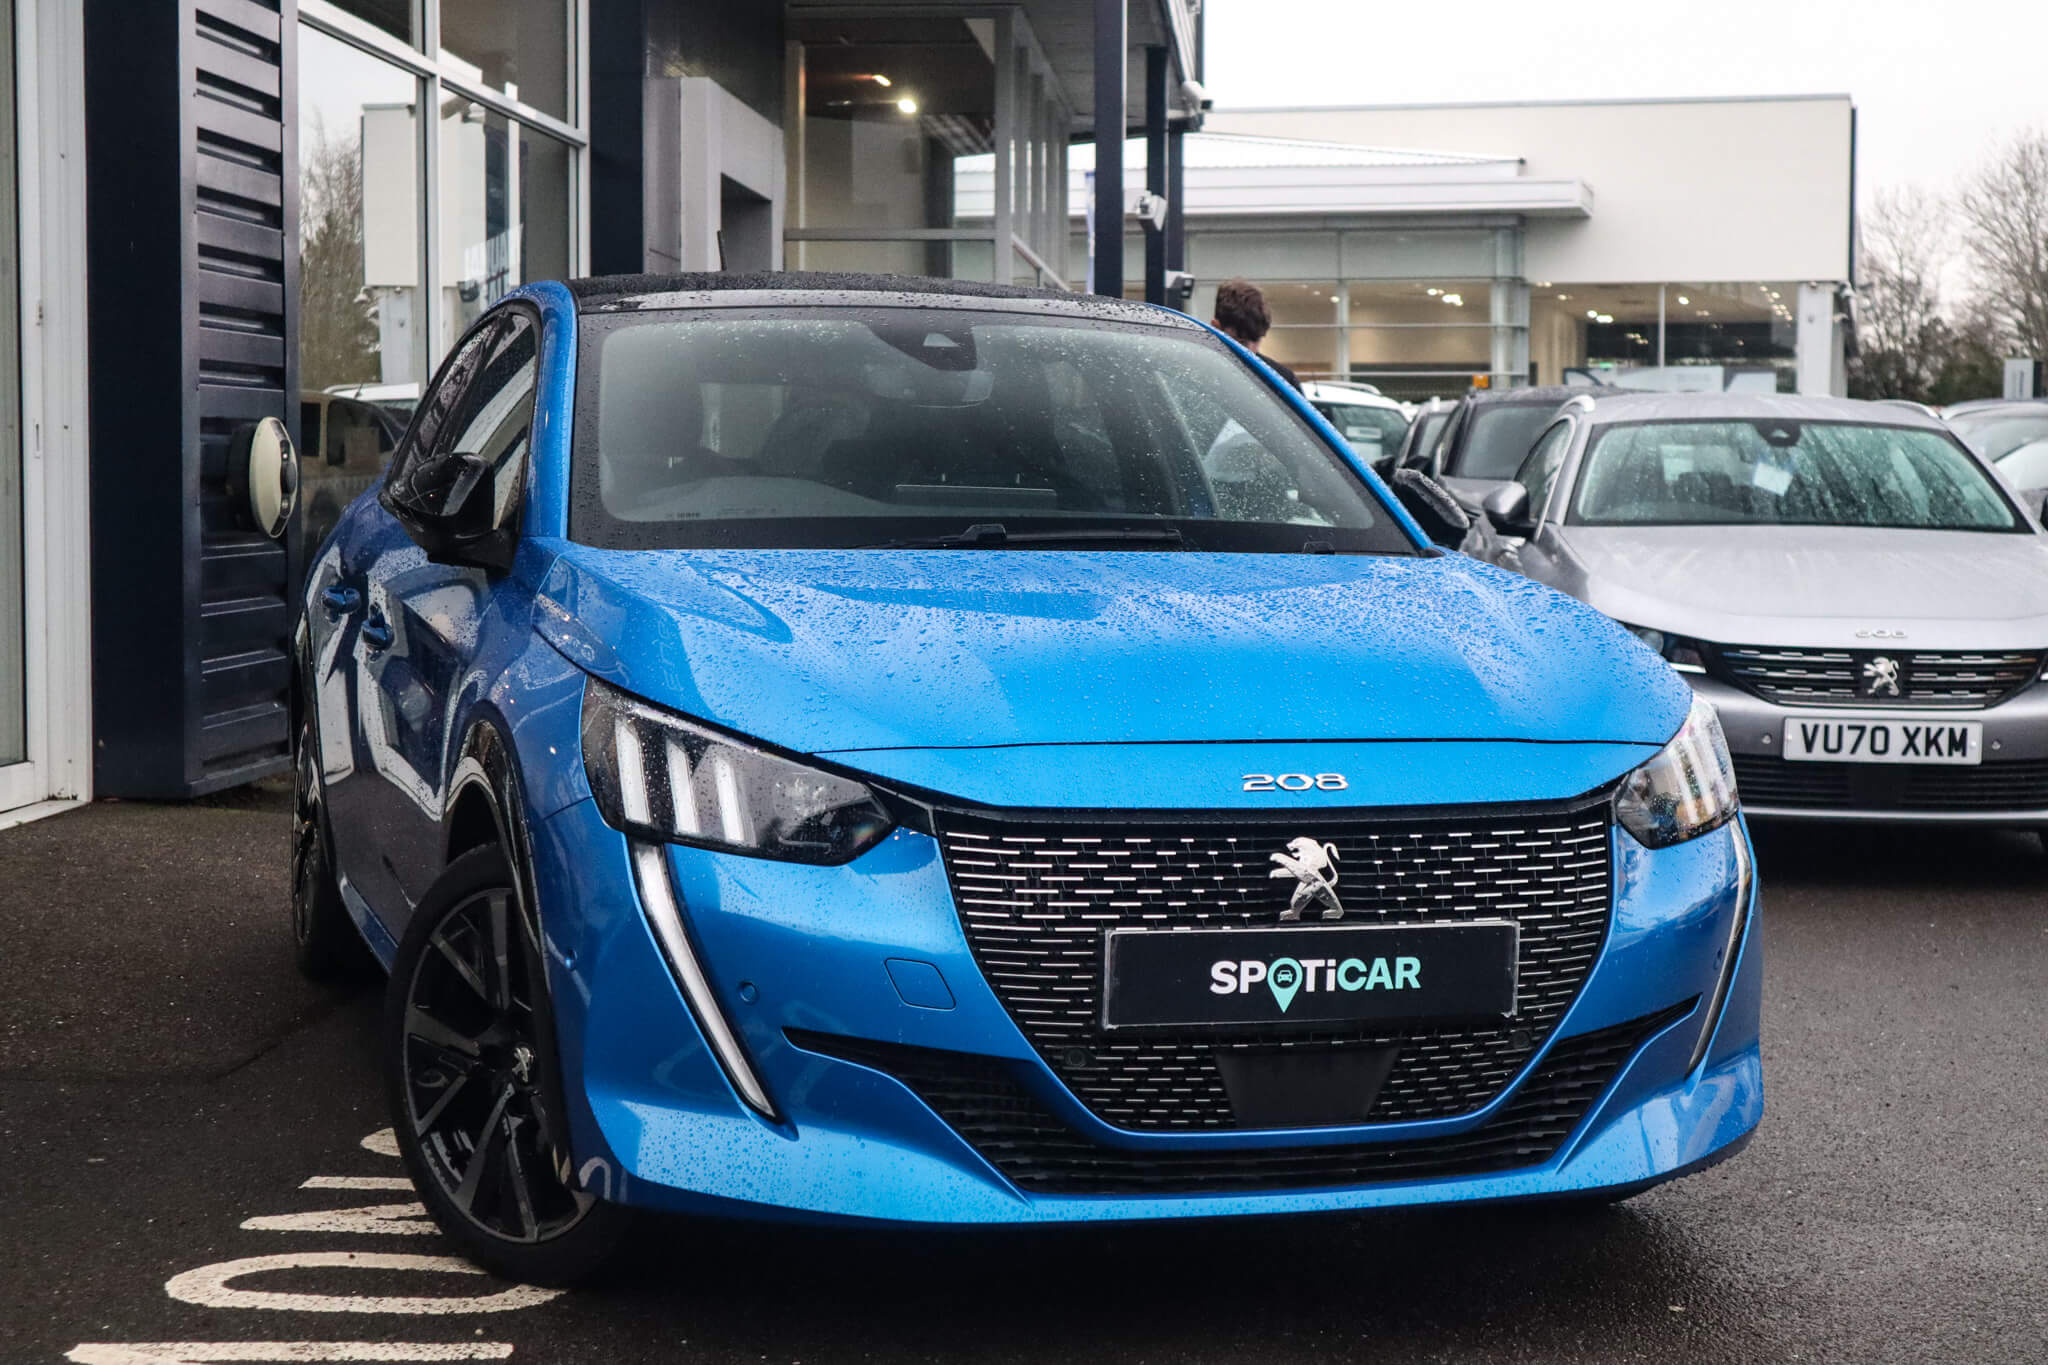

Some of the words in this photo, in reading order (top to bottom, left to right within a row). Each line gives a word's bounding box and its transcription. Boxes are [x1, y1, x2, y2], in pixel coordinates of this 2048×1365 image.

[1801, 723, 1890, 756] VU70
[1901, 725, 1968, 758] XKM
[1242, 773, 1349, 791] 208
